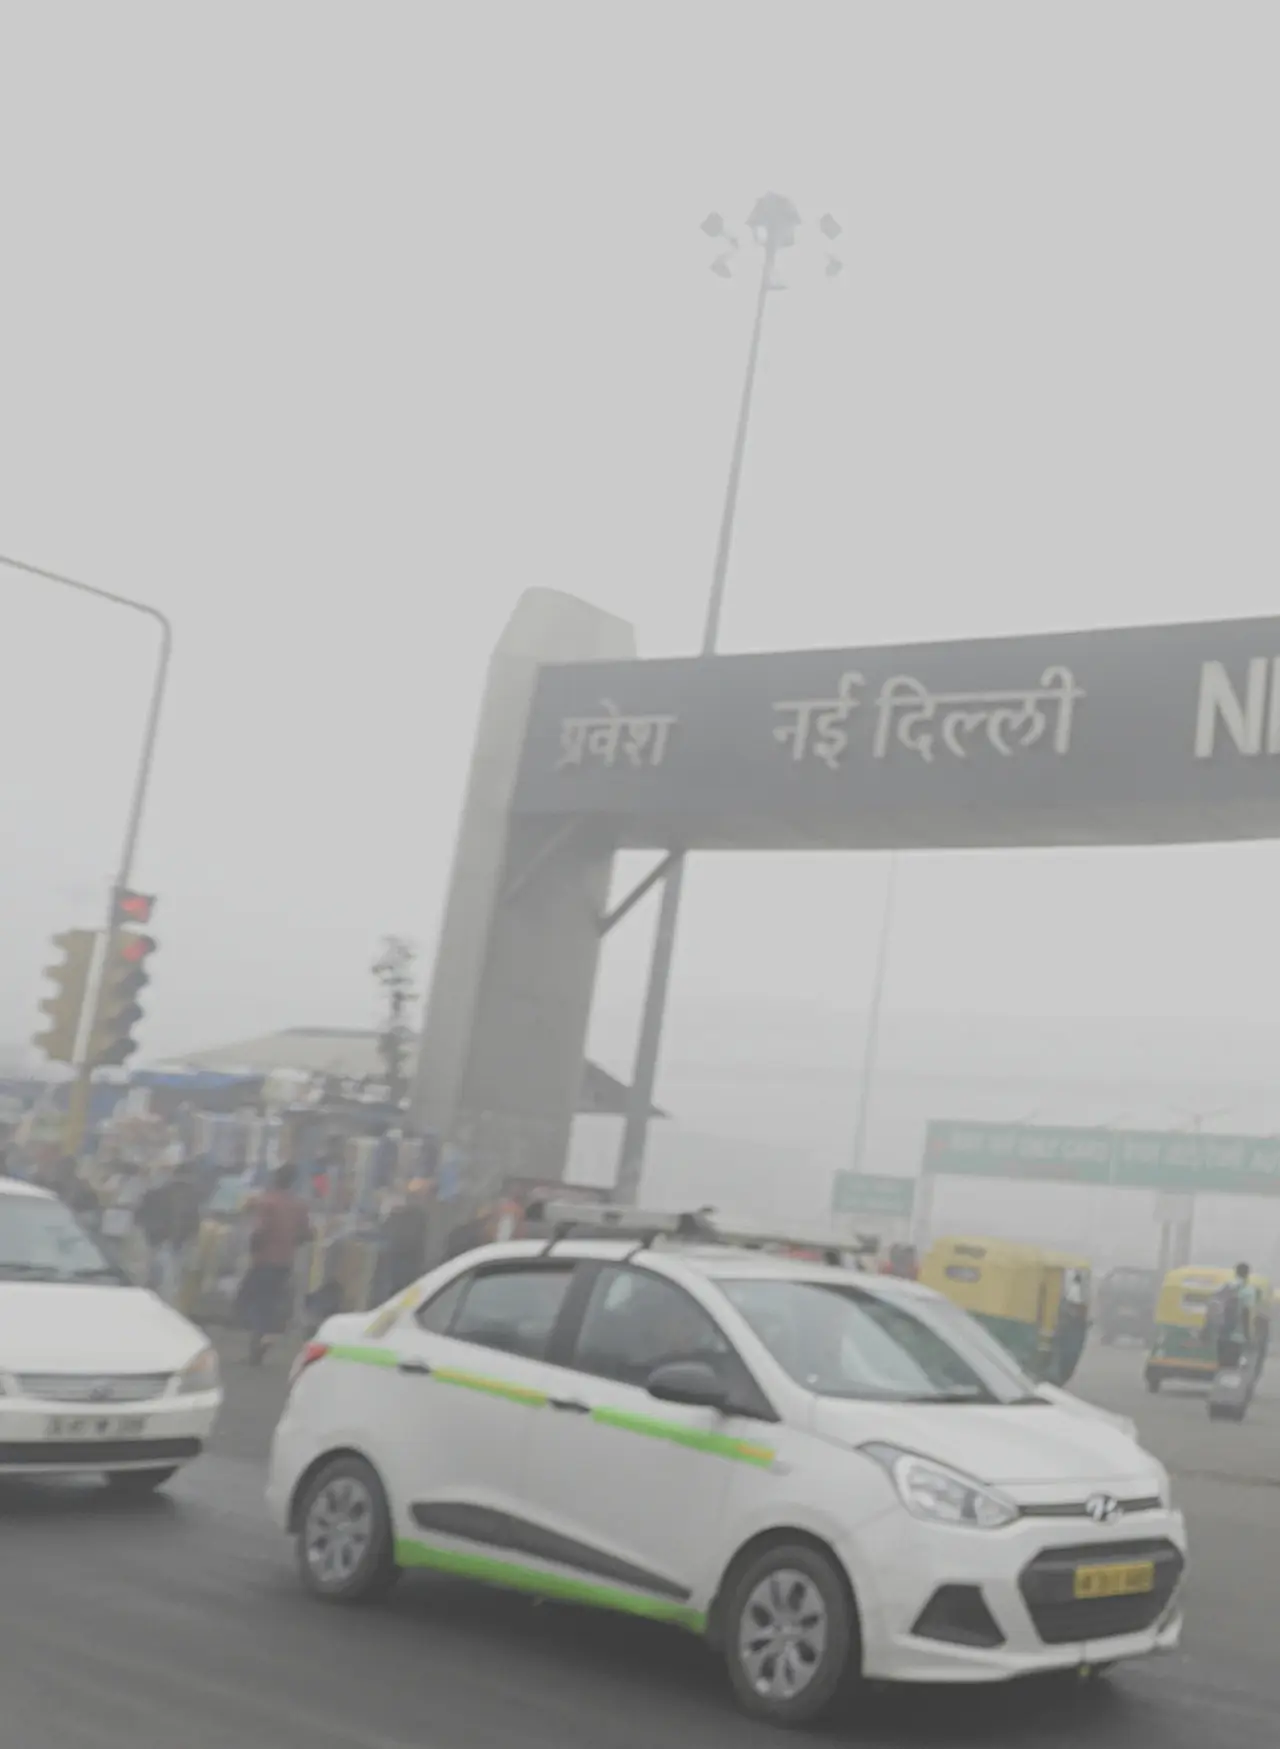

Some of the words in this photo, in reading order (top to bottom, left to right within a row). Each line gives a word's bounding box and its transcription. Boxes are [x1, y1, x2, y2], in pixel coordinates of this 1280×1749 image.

[556, 701, 678, 767] प्रवेश
[772, 671, 866, 769] नई
[873, 665, 1085, 762] दिल्ली
